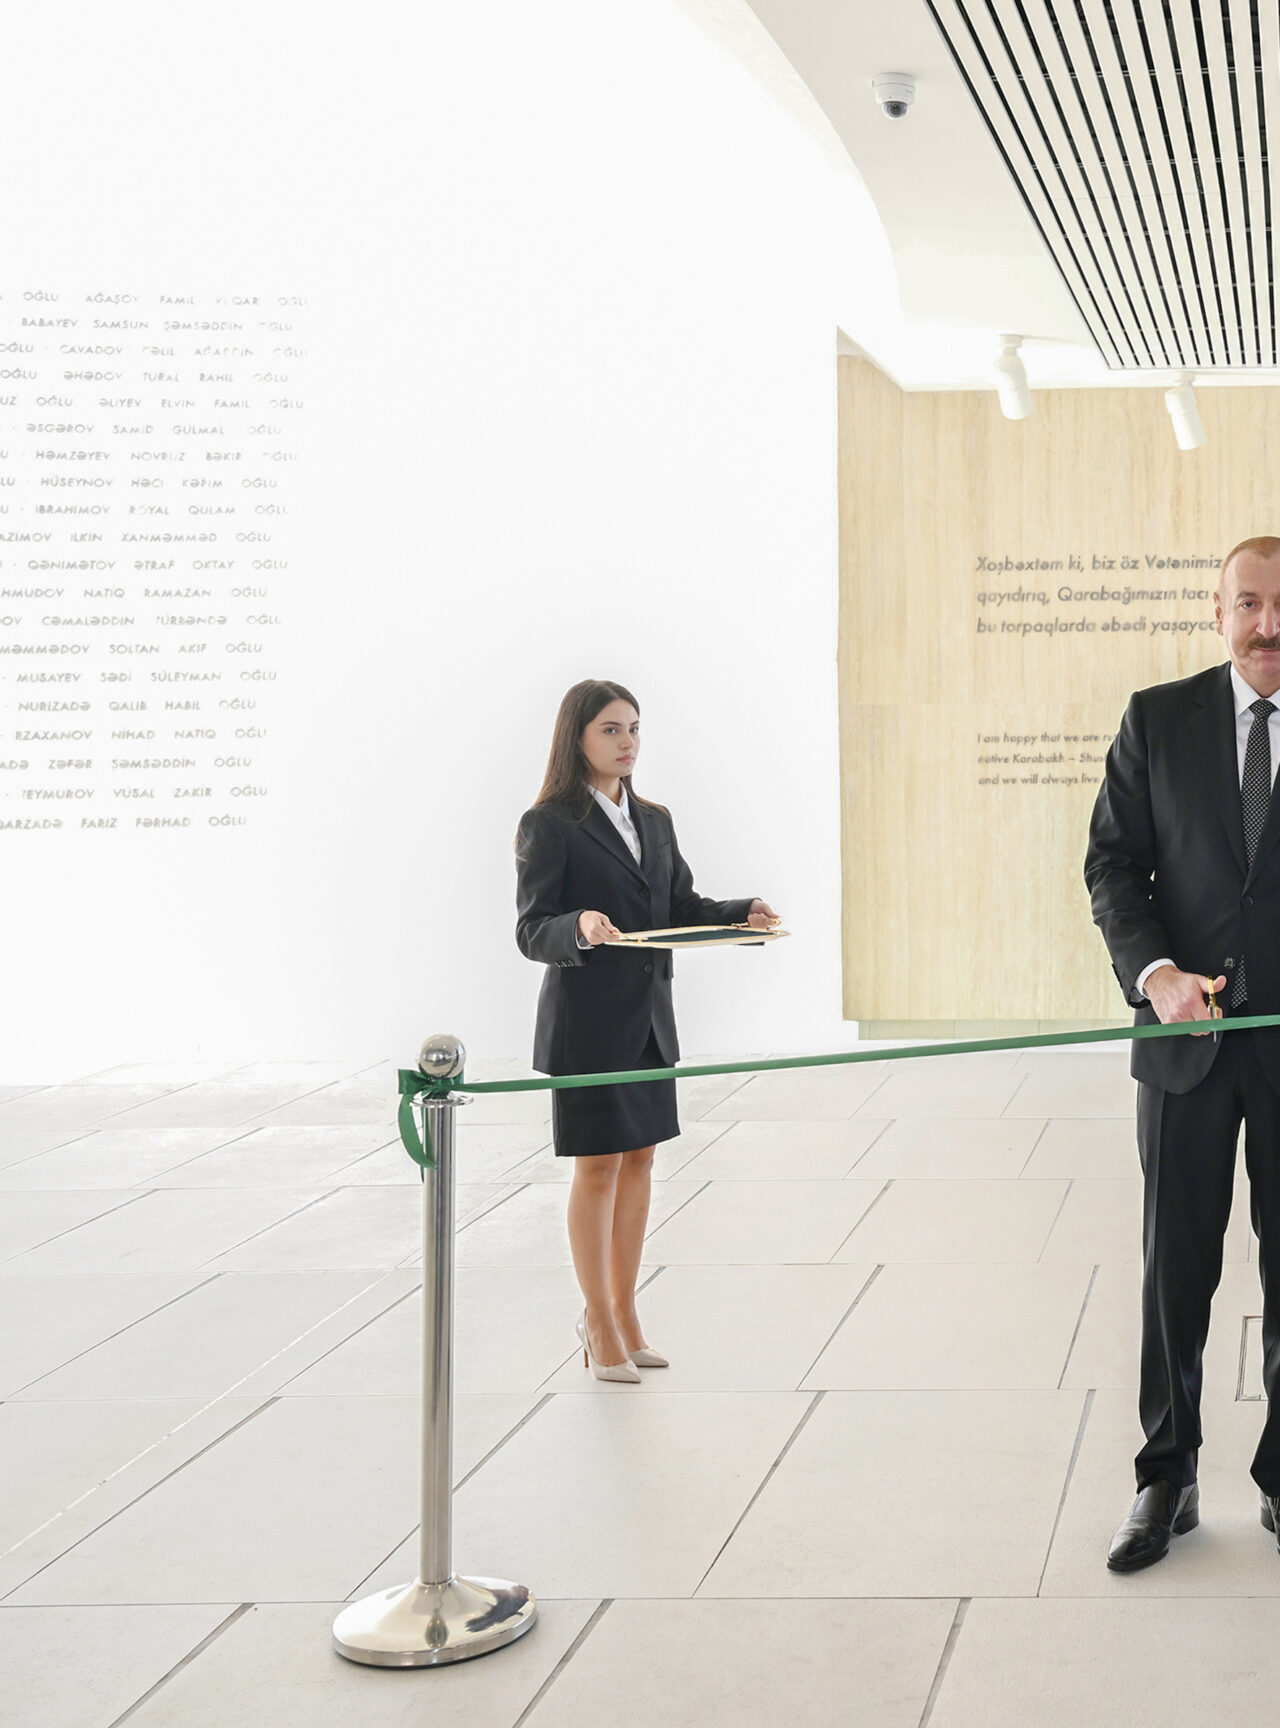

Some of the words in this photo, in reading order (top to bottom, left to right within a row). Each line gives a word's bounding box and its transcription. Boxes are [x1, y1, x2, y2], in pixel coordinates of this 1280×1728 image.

[20, 316, 79, 329] BABAYEV
[92, 318, 150, 331] SAMSUN
[141, 371, 180, 383] TURAL
[34, 448, 112, 463] HƏMZƏYEV
[191, 559, 236, 571] OKTAY
[975, 556, 1064, 575] Xoşbəxtəm
[1068, 554, 1086, 573] ki,
[1091, 554, 1116, 571] biz
[1120, 556, 1141, 571] öz
[143, 587, 213, 599] RAMAZAN
[976, 586, 1051, 608] qayıdırıq,
[1057, 585, 1177, 605] Qarabağımızın
[1181, 586, 1209, 601] tacı
[976, 617, 997, 633] bu
[1001, 616, 1096, 637] torpaqlarda
[1100, 616, 1147, 633] əbədi
[108, 643, 161, 656] SOLTAN
[15, 671, 83, 685] MUSAYEV
[983, 735, 1000, 744] am
[1003, 732, 1038, 746] happy
[1040, 732, 1061, 743] that
[1063, 734, 1080, 743] we
[1082, 734, 1099, 743] are
[47, 758, 94, 771] ZƏFƏR
[977, 753, 1009, 764] native
[1012, 753, 1065, 764] Karabakh
[978, 774, 1000, 785] and
[1001, 776, 1017, 785] we
[1020, 773, 1038, 785] will
[1041, 774, 1079, 787] always
[1081, 773, 1100, 784] live
[135, 816, 192, 830] FƏRHAD
